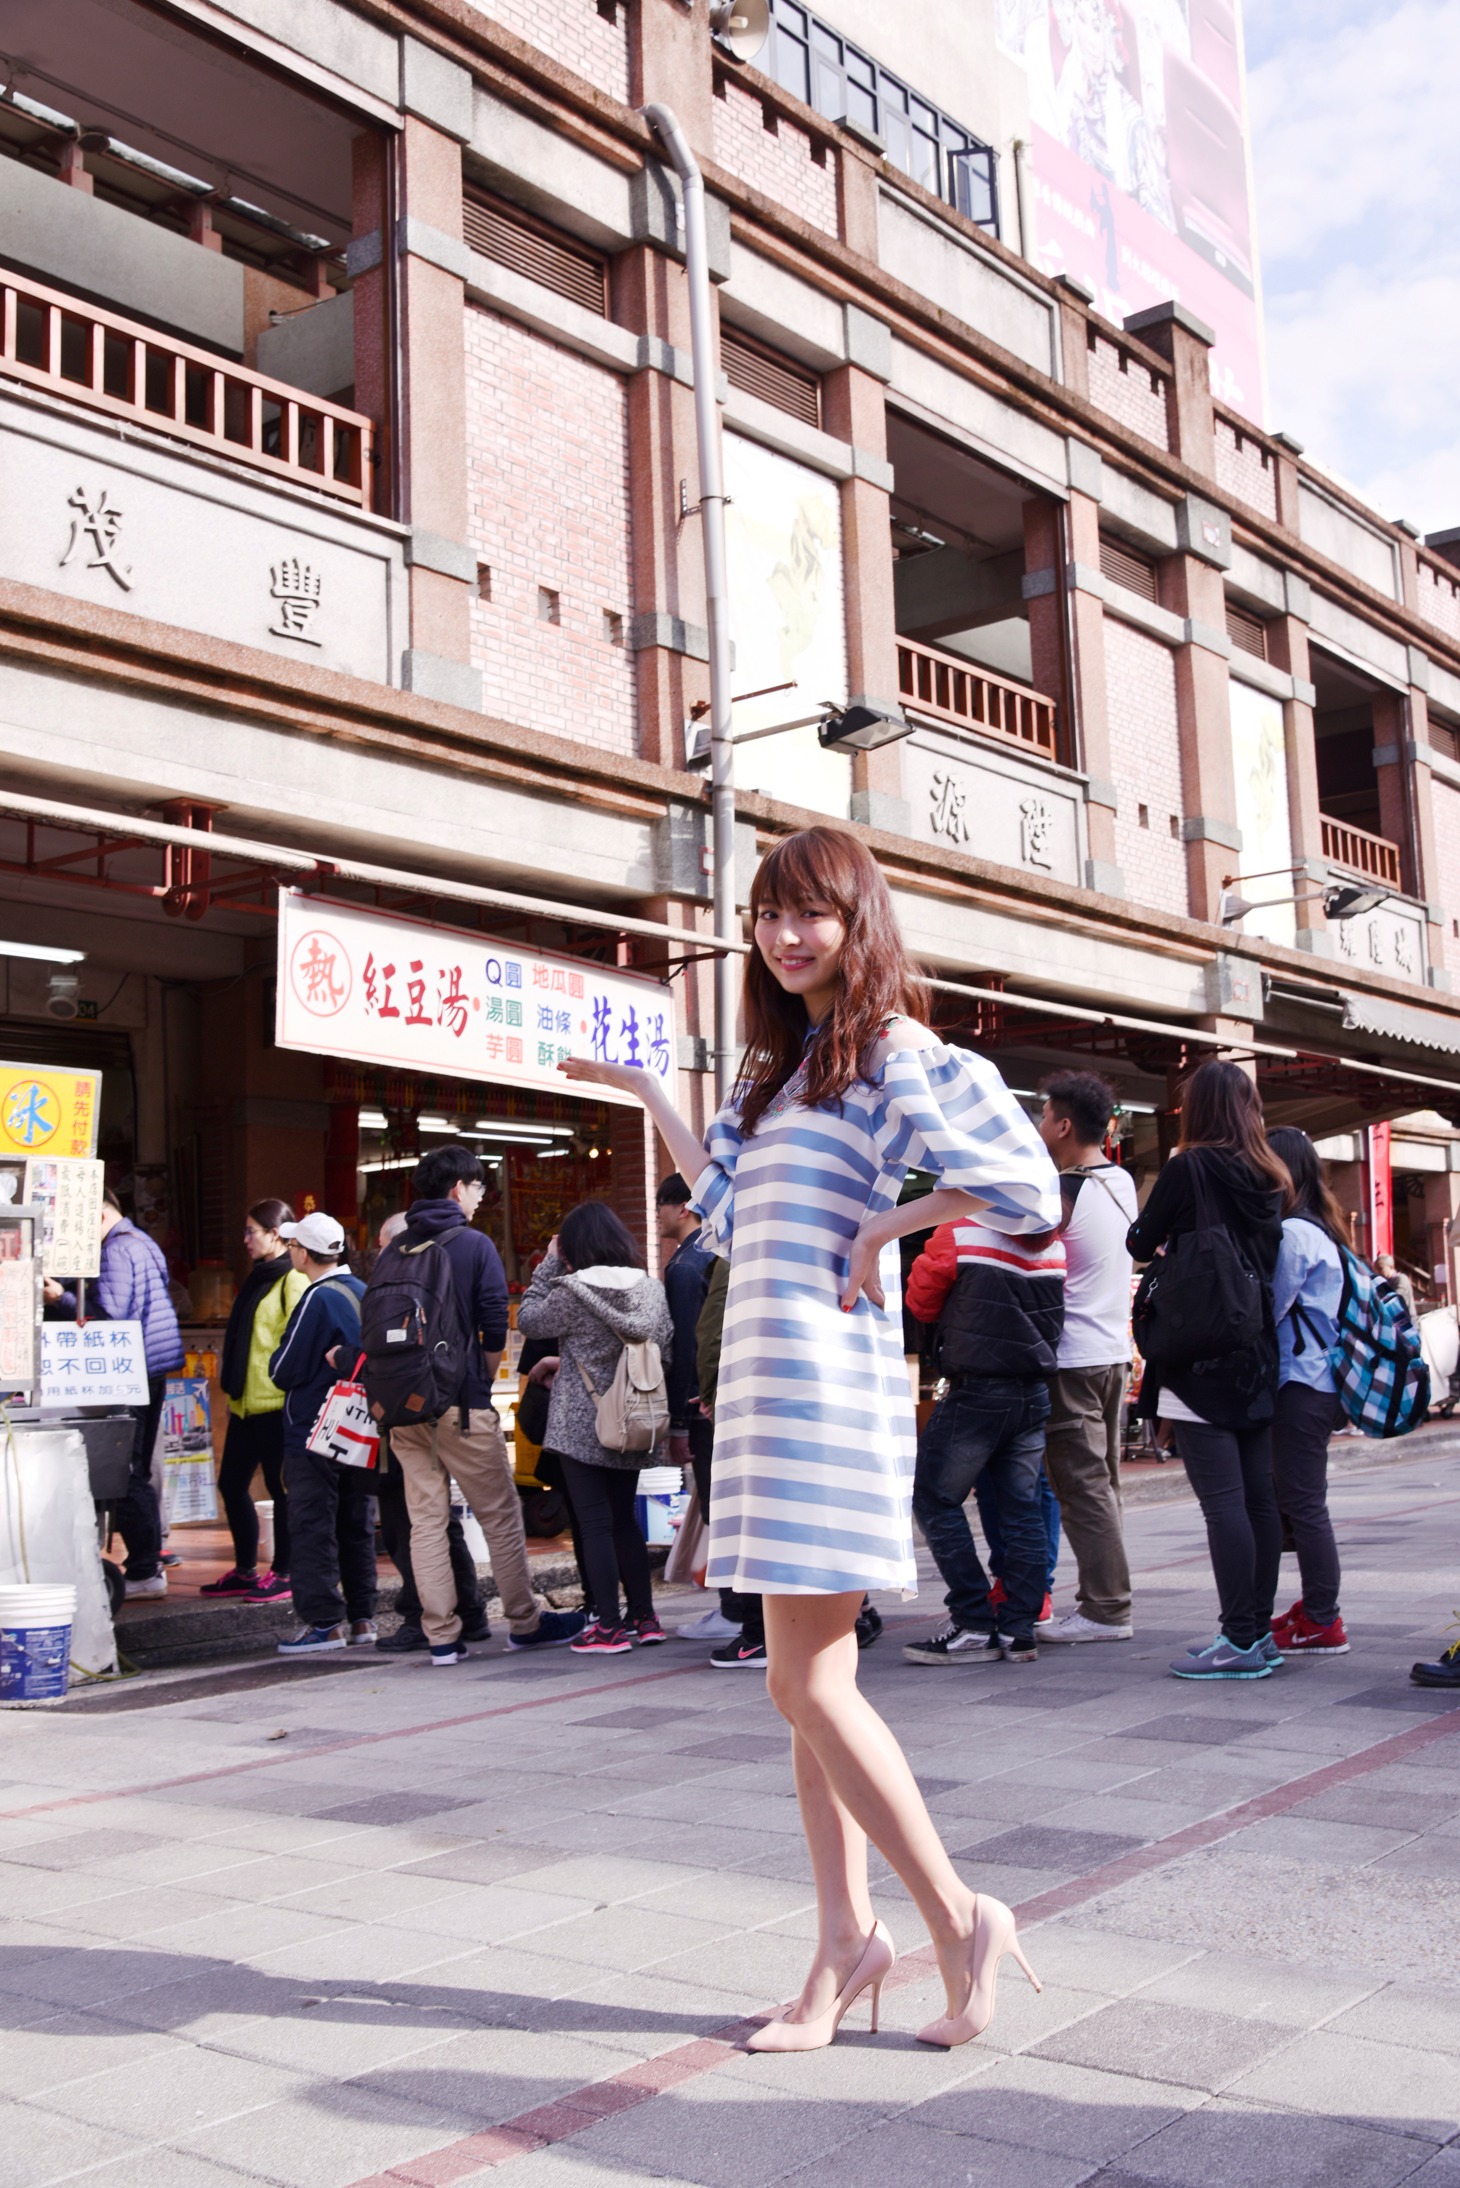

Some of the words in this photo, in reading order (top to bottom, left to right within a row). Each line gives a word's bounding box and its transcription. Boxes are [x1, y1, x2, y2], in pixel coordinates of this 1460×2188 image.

[300, 937, 345, 1009] 熱
[486, 958, 523, 989] Q圓
[532, 963, 584, 999] 地瓜圓
[363, 951, 469, 1038] 紅豆湯
[486, 995, 523, 1027] 湯圓
[537, 1003, 572, 1035] 油條
[591, 995, 670, 1078] 花生湯
[486, 1033, 523, 1064] 芋圓
[8, 1084, 54, 1143] 冰
[70, 1081, 91, 1156] 請先付款
[41, 1384, 142, 1397] 用紙杯加5元
